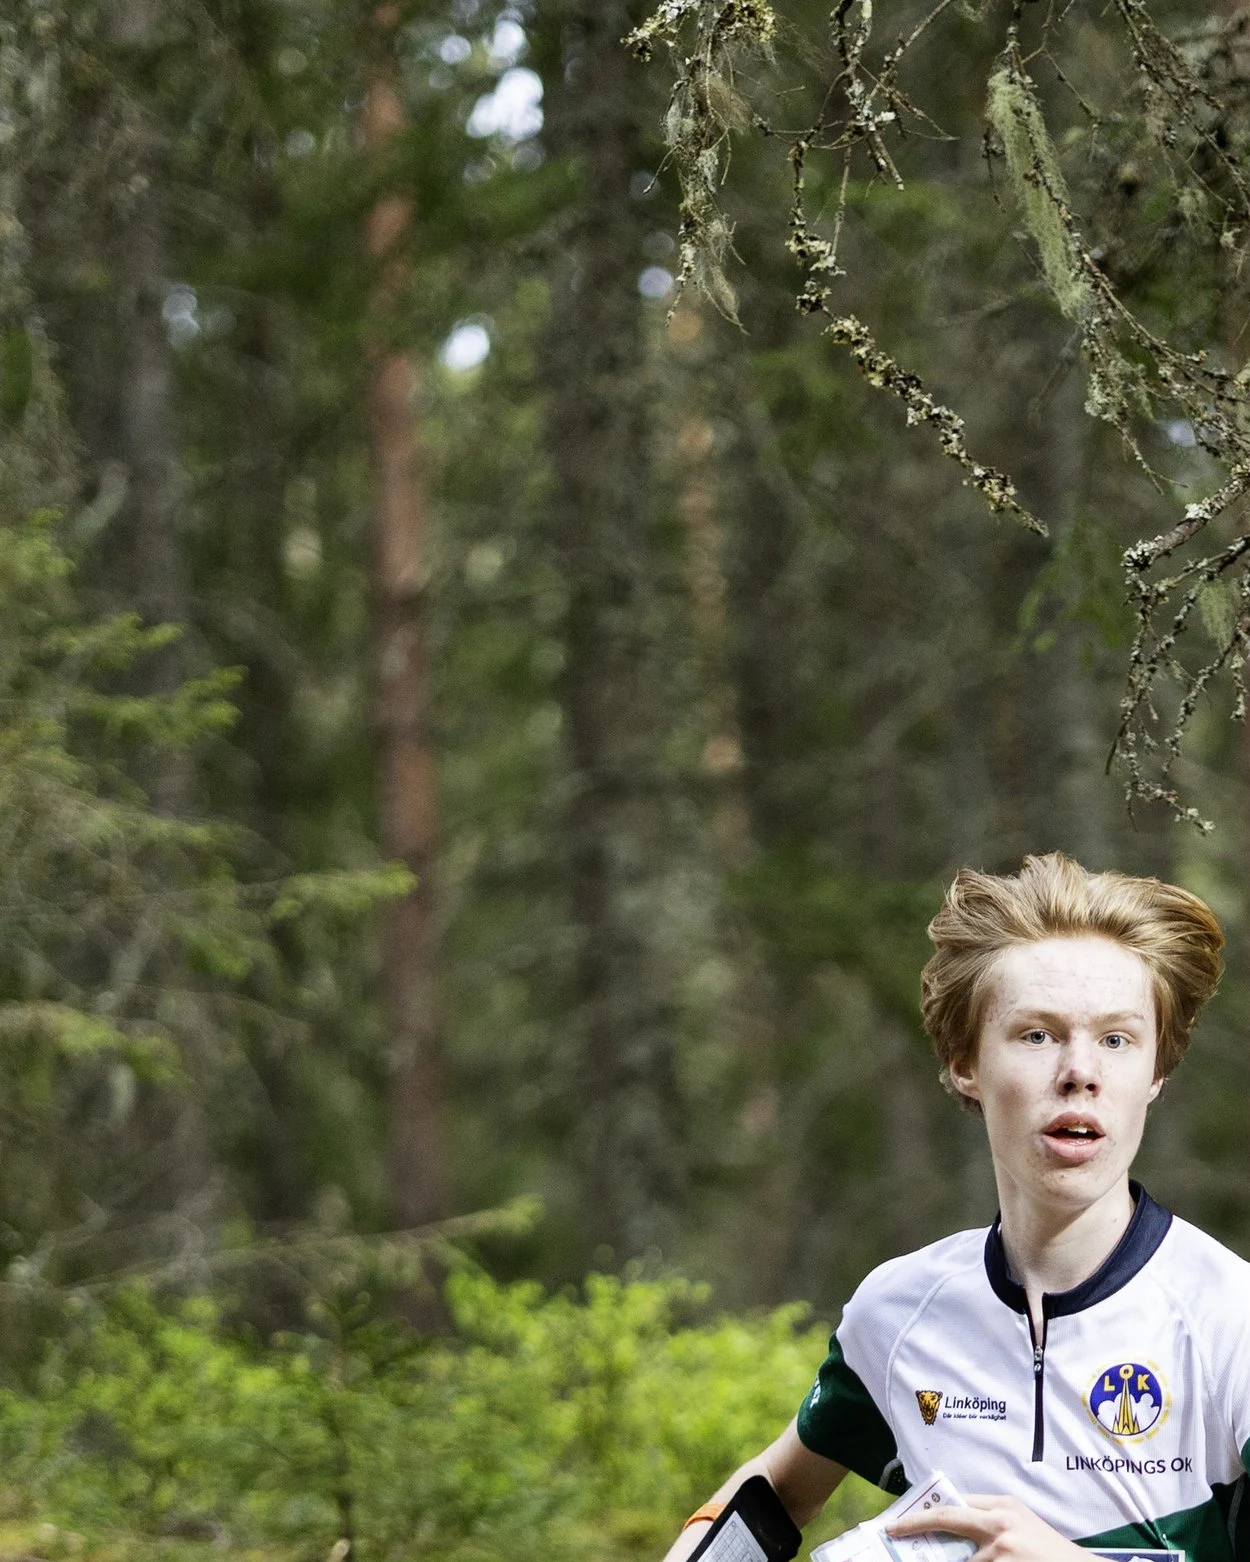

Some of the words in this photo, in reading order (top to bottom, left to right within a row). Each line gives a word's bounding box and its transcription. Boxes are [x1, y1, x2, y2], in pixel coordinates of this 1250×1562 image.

[945, 1396, 1006, 1413] Linköping
[1066, 1455, 1166, 1475] LINKÖPINGS
[1171, 1457, 1193, 1473] OK
